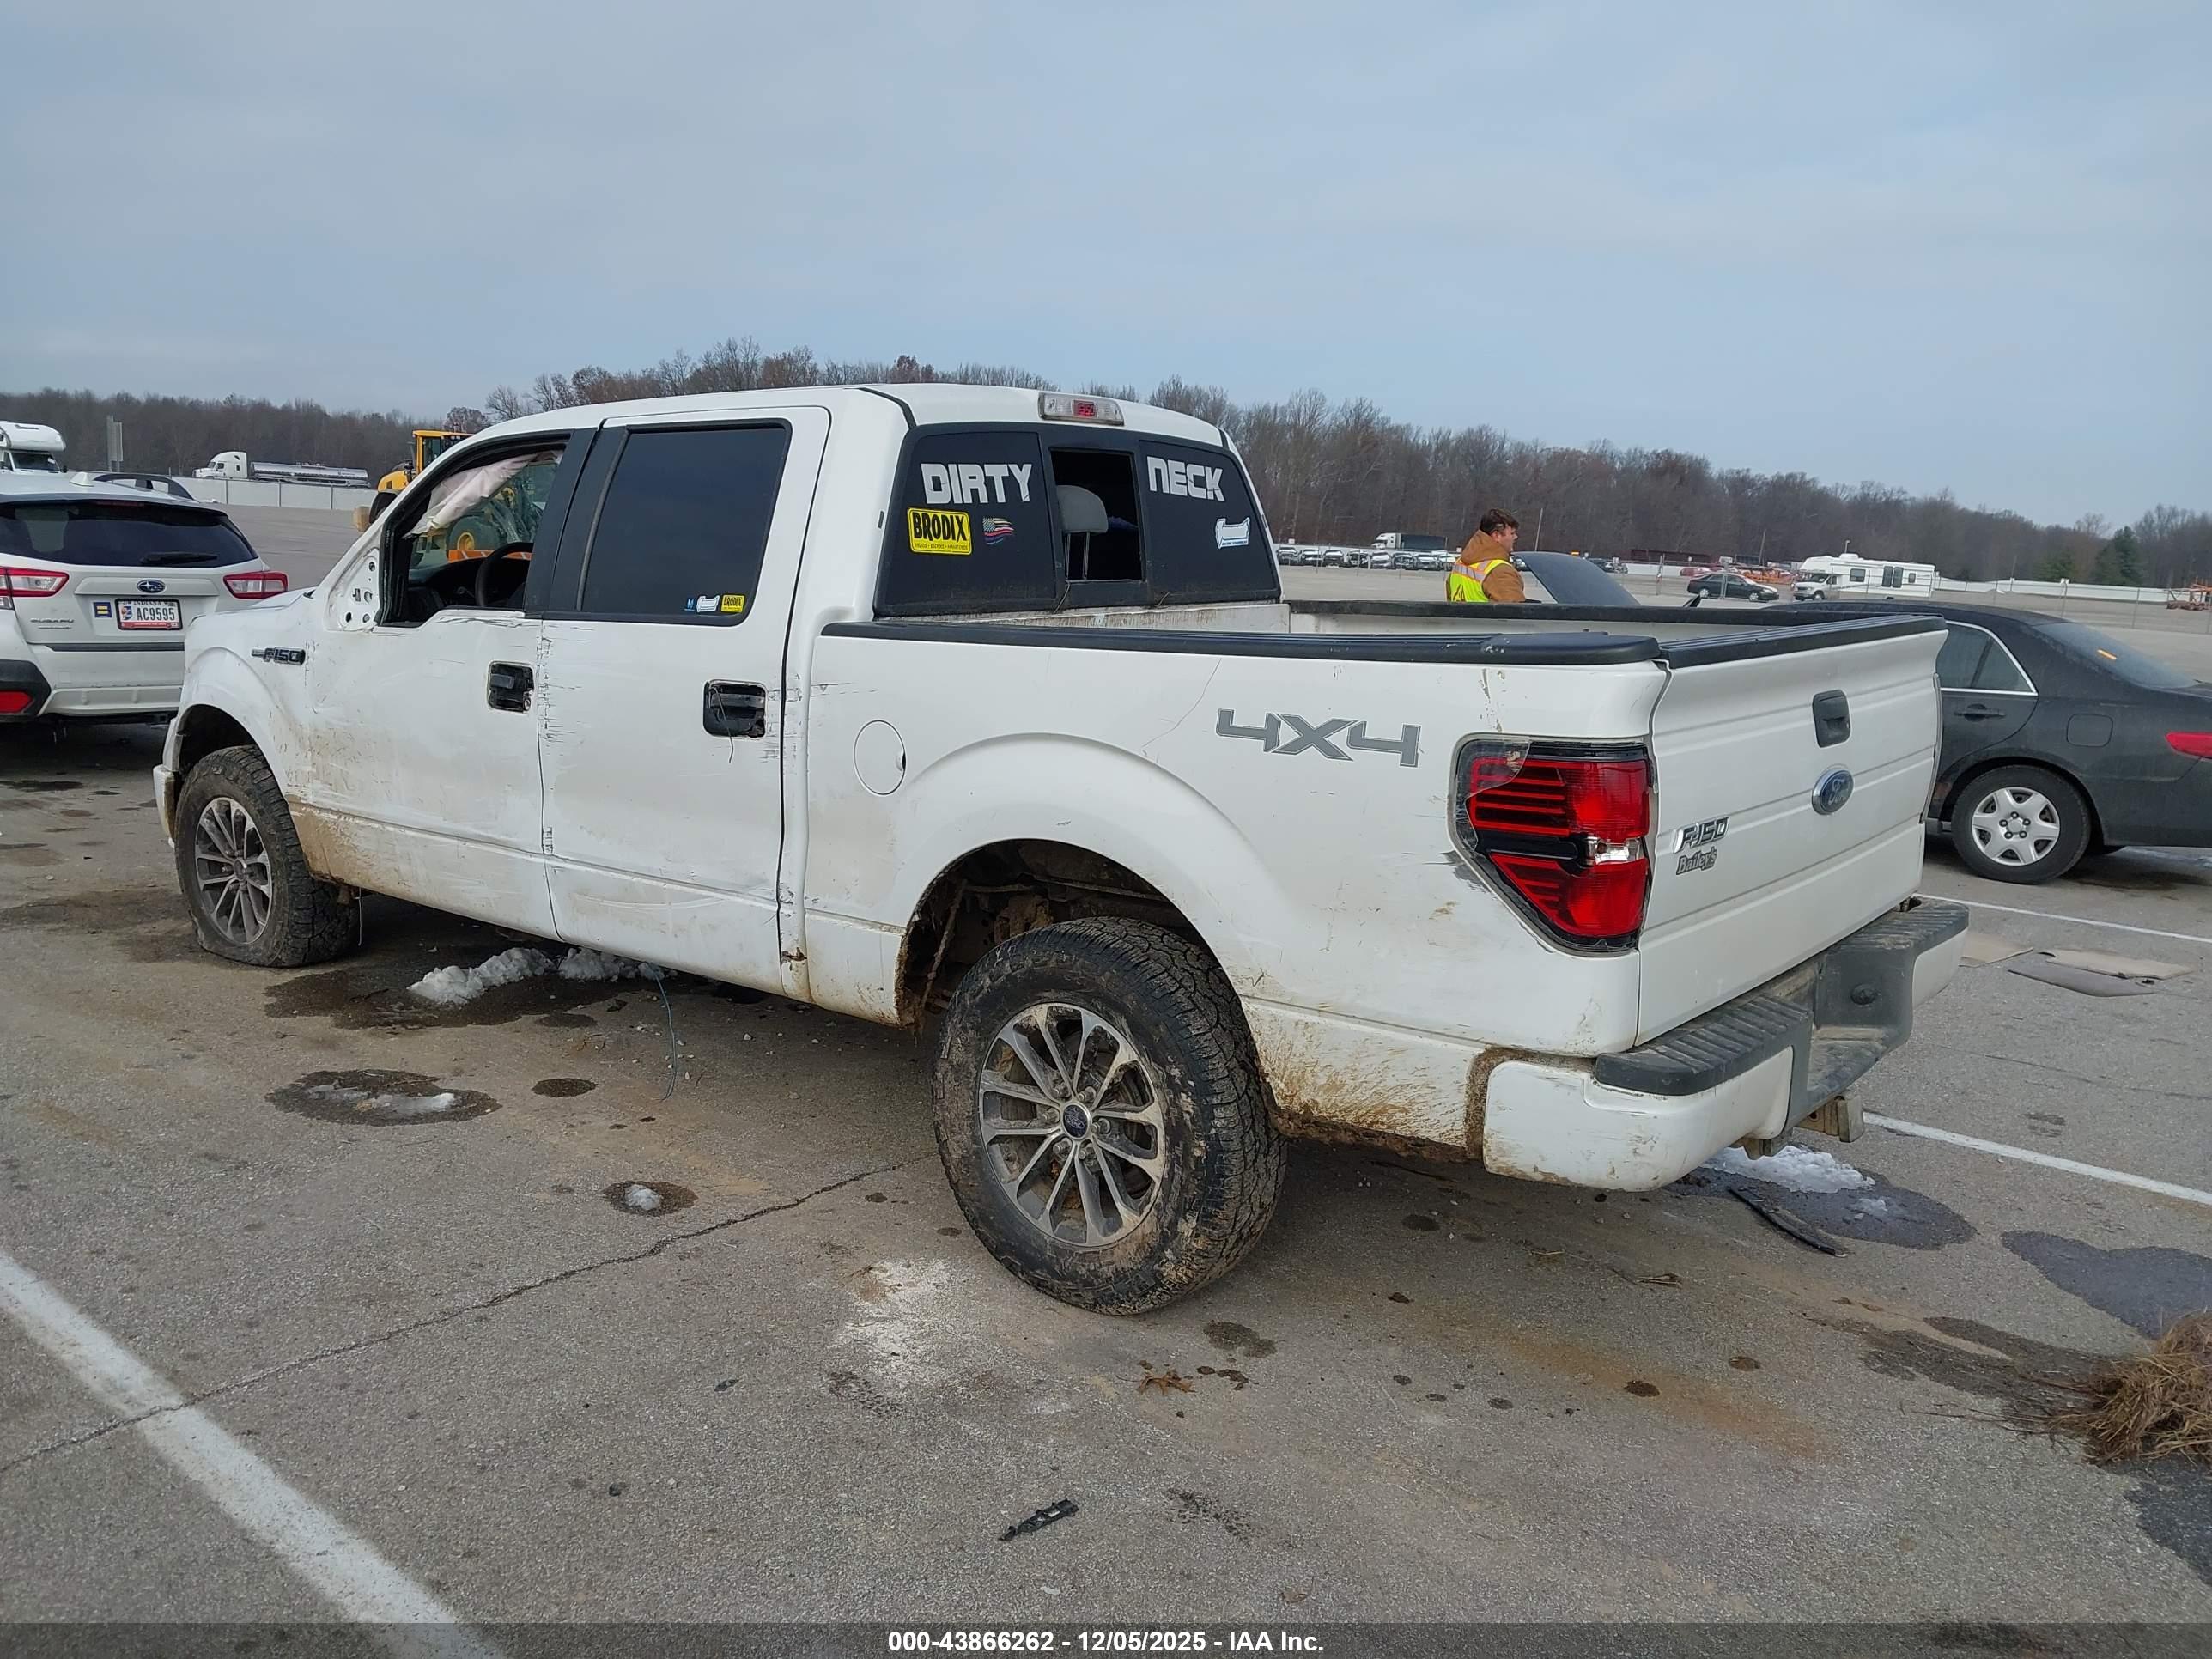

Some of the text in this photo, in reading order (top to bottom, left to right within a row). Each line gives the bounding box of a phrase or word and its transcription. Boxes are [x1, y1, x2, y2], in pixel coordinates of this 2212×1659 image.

[921, 456, 1225, 504] DIRTY NECK
[912, 512, 968, 543] BRODIX
[137, 607, 175, 621] AC9595
